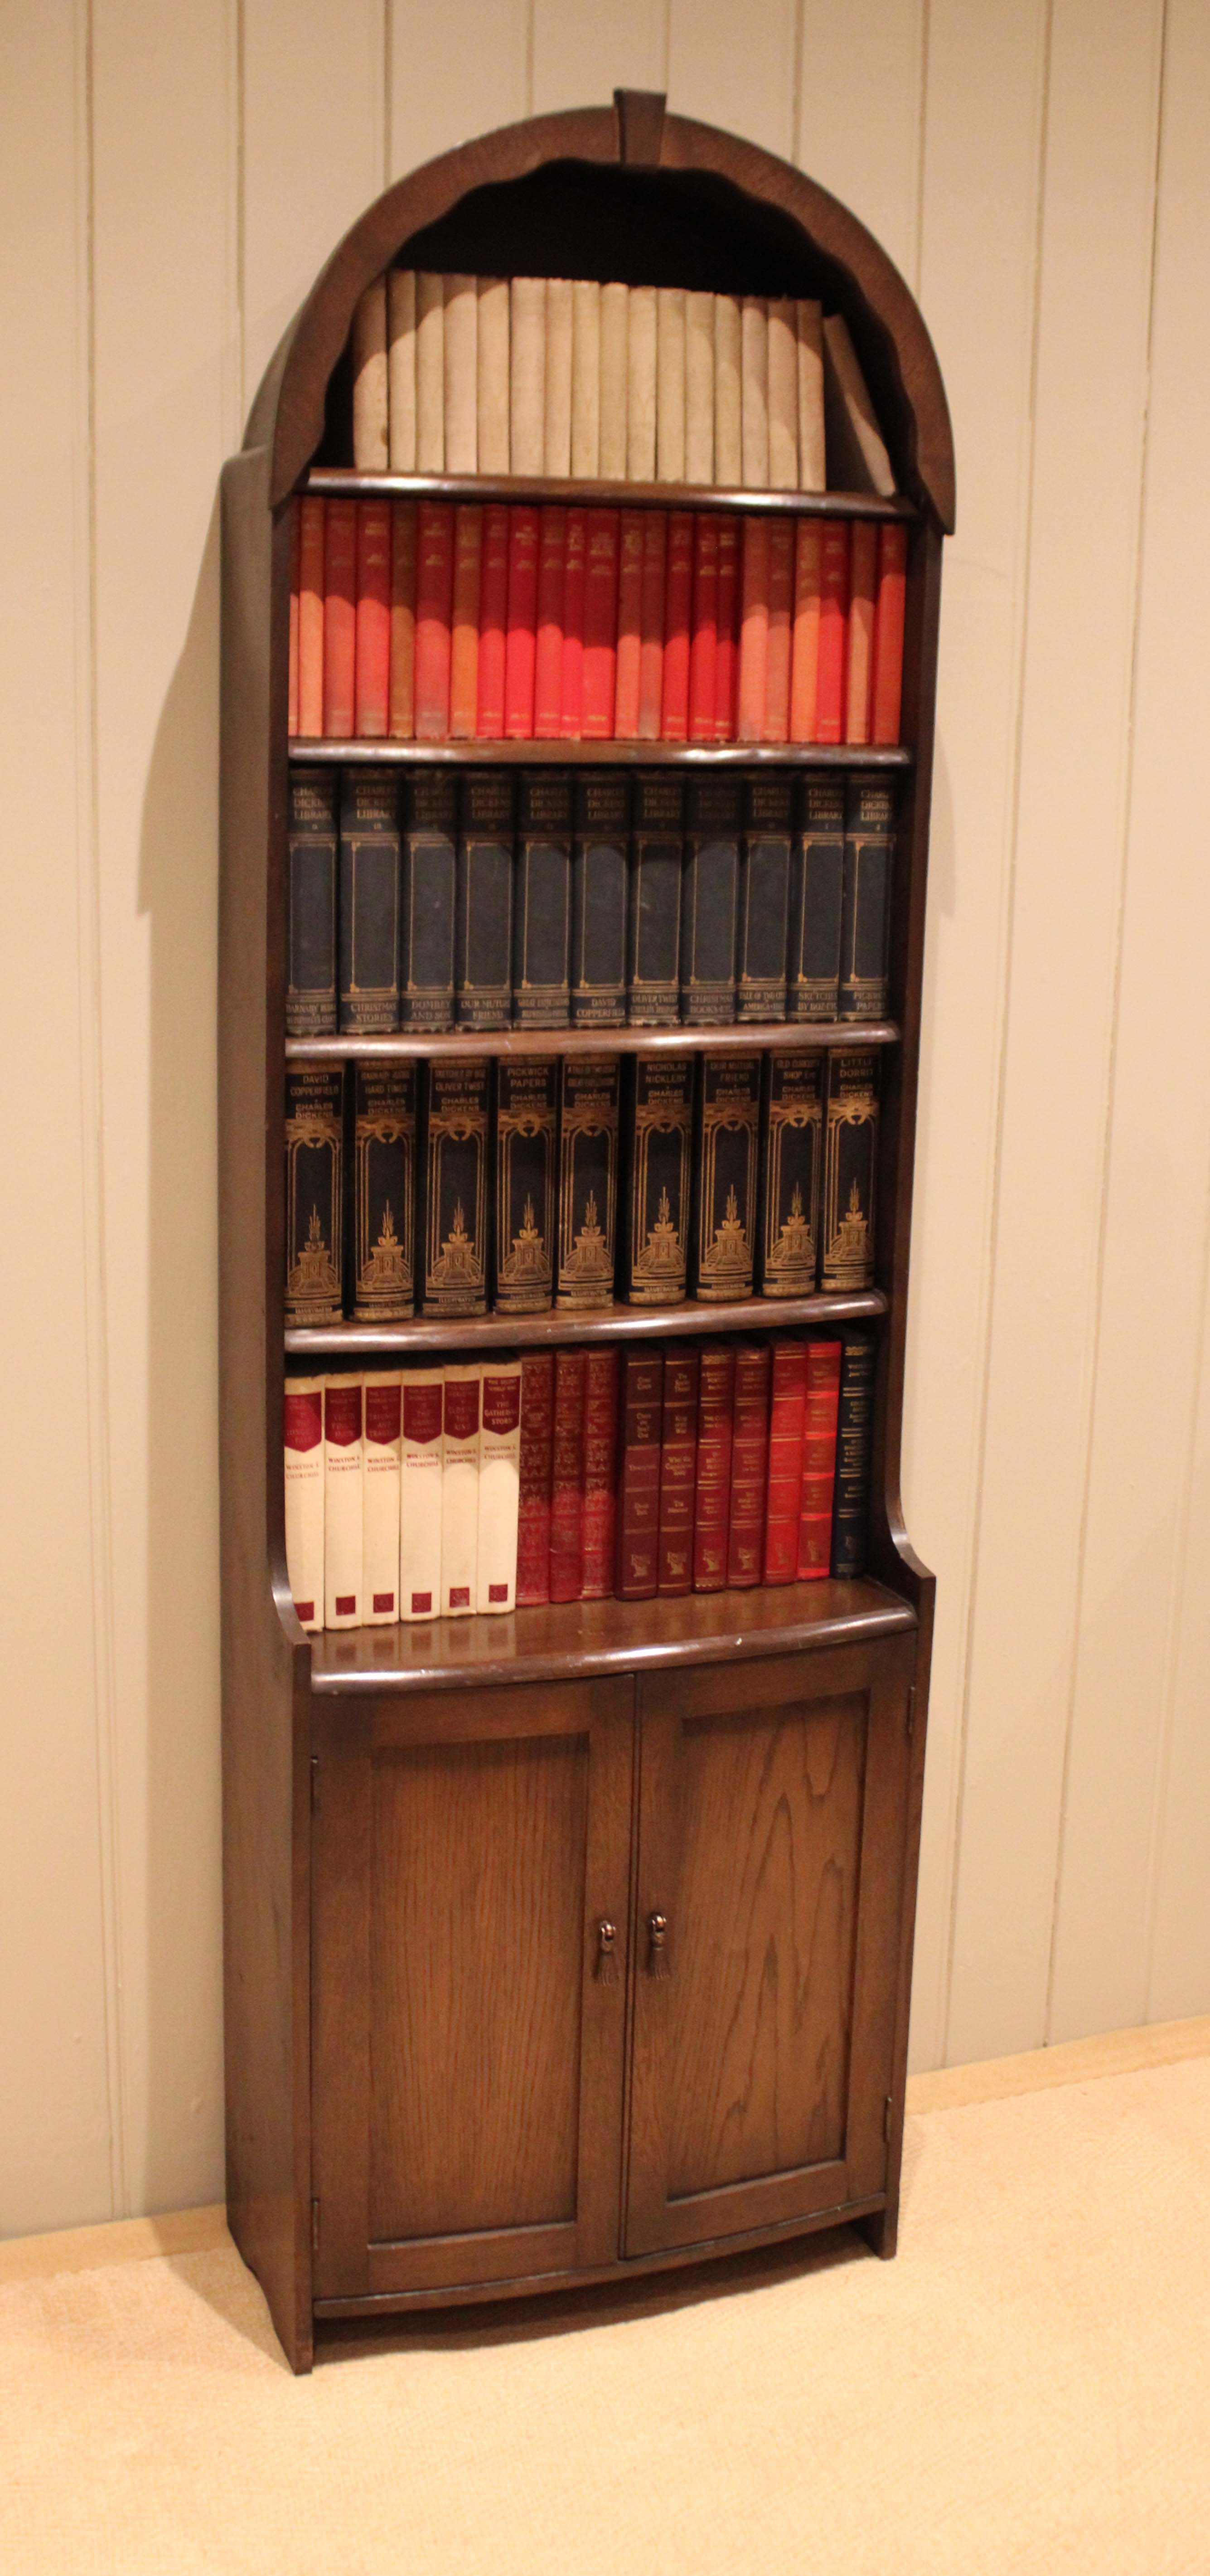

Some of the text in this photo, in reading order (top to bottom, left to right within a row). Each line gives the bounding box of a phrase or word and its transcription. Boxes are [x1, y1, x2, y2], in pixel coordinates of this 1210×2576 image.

[647, 1062, 687, 1072] NICHOLAS
[507, 1067, 549, 1077] PICKWICK
[303, 1075, 329, 1084] DAVID
[510, 1078, 547, 1088] PAPERS
[645, 1074, 687, 1083] NICKLEBY
[441, 1097, 479, 1105] CHARLES
